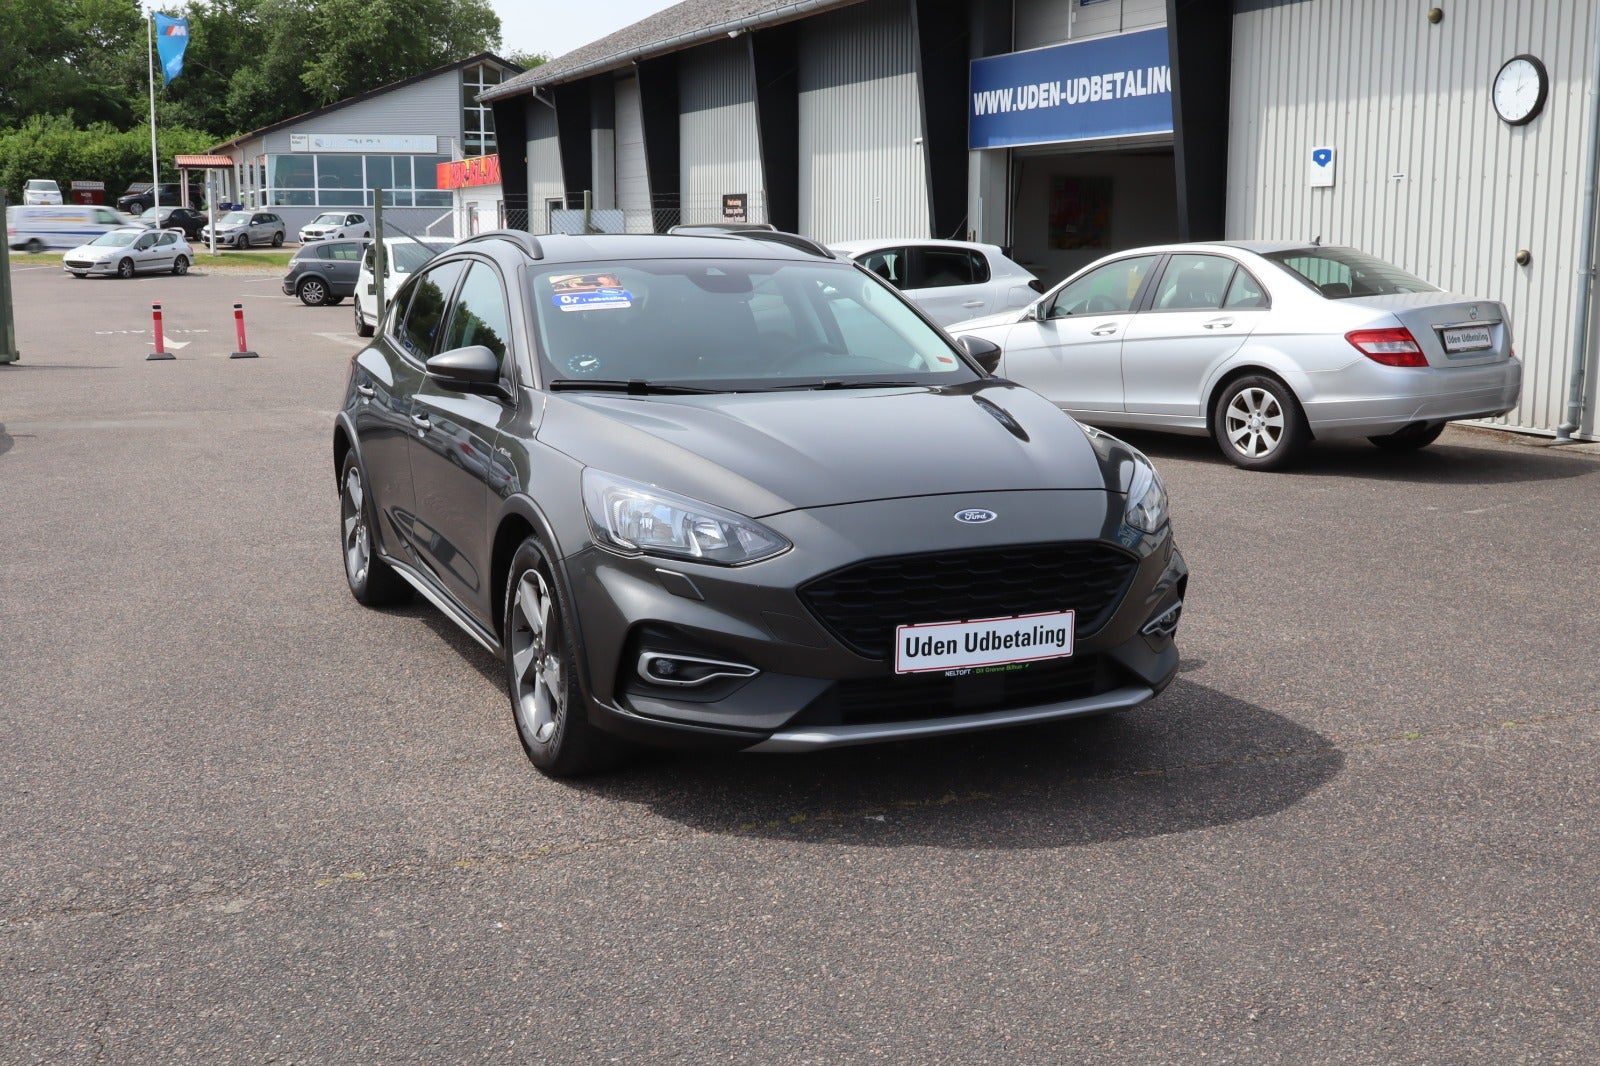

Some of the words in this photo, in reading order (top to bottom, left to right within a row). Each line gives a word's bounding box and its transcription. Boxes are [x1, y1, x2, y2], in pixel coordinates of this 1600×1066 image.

[1447, 335, 1461, 344] Uden
[1462, 333, 1488, 343] Udbetaling
[965, 511, 987, 520] Ford
[906, 636, 957, 657] Uden
[965, 625, 1066, 653] Udbetaling
[945, 669, 971, 677] NELTOFT
